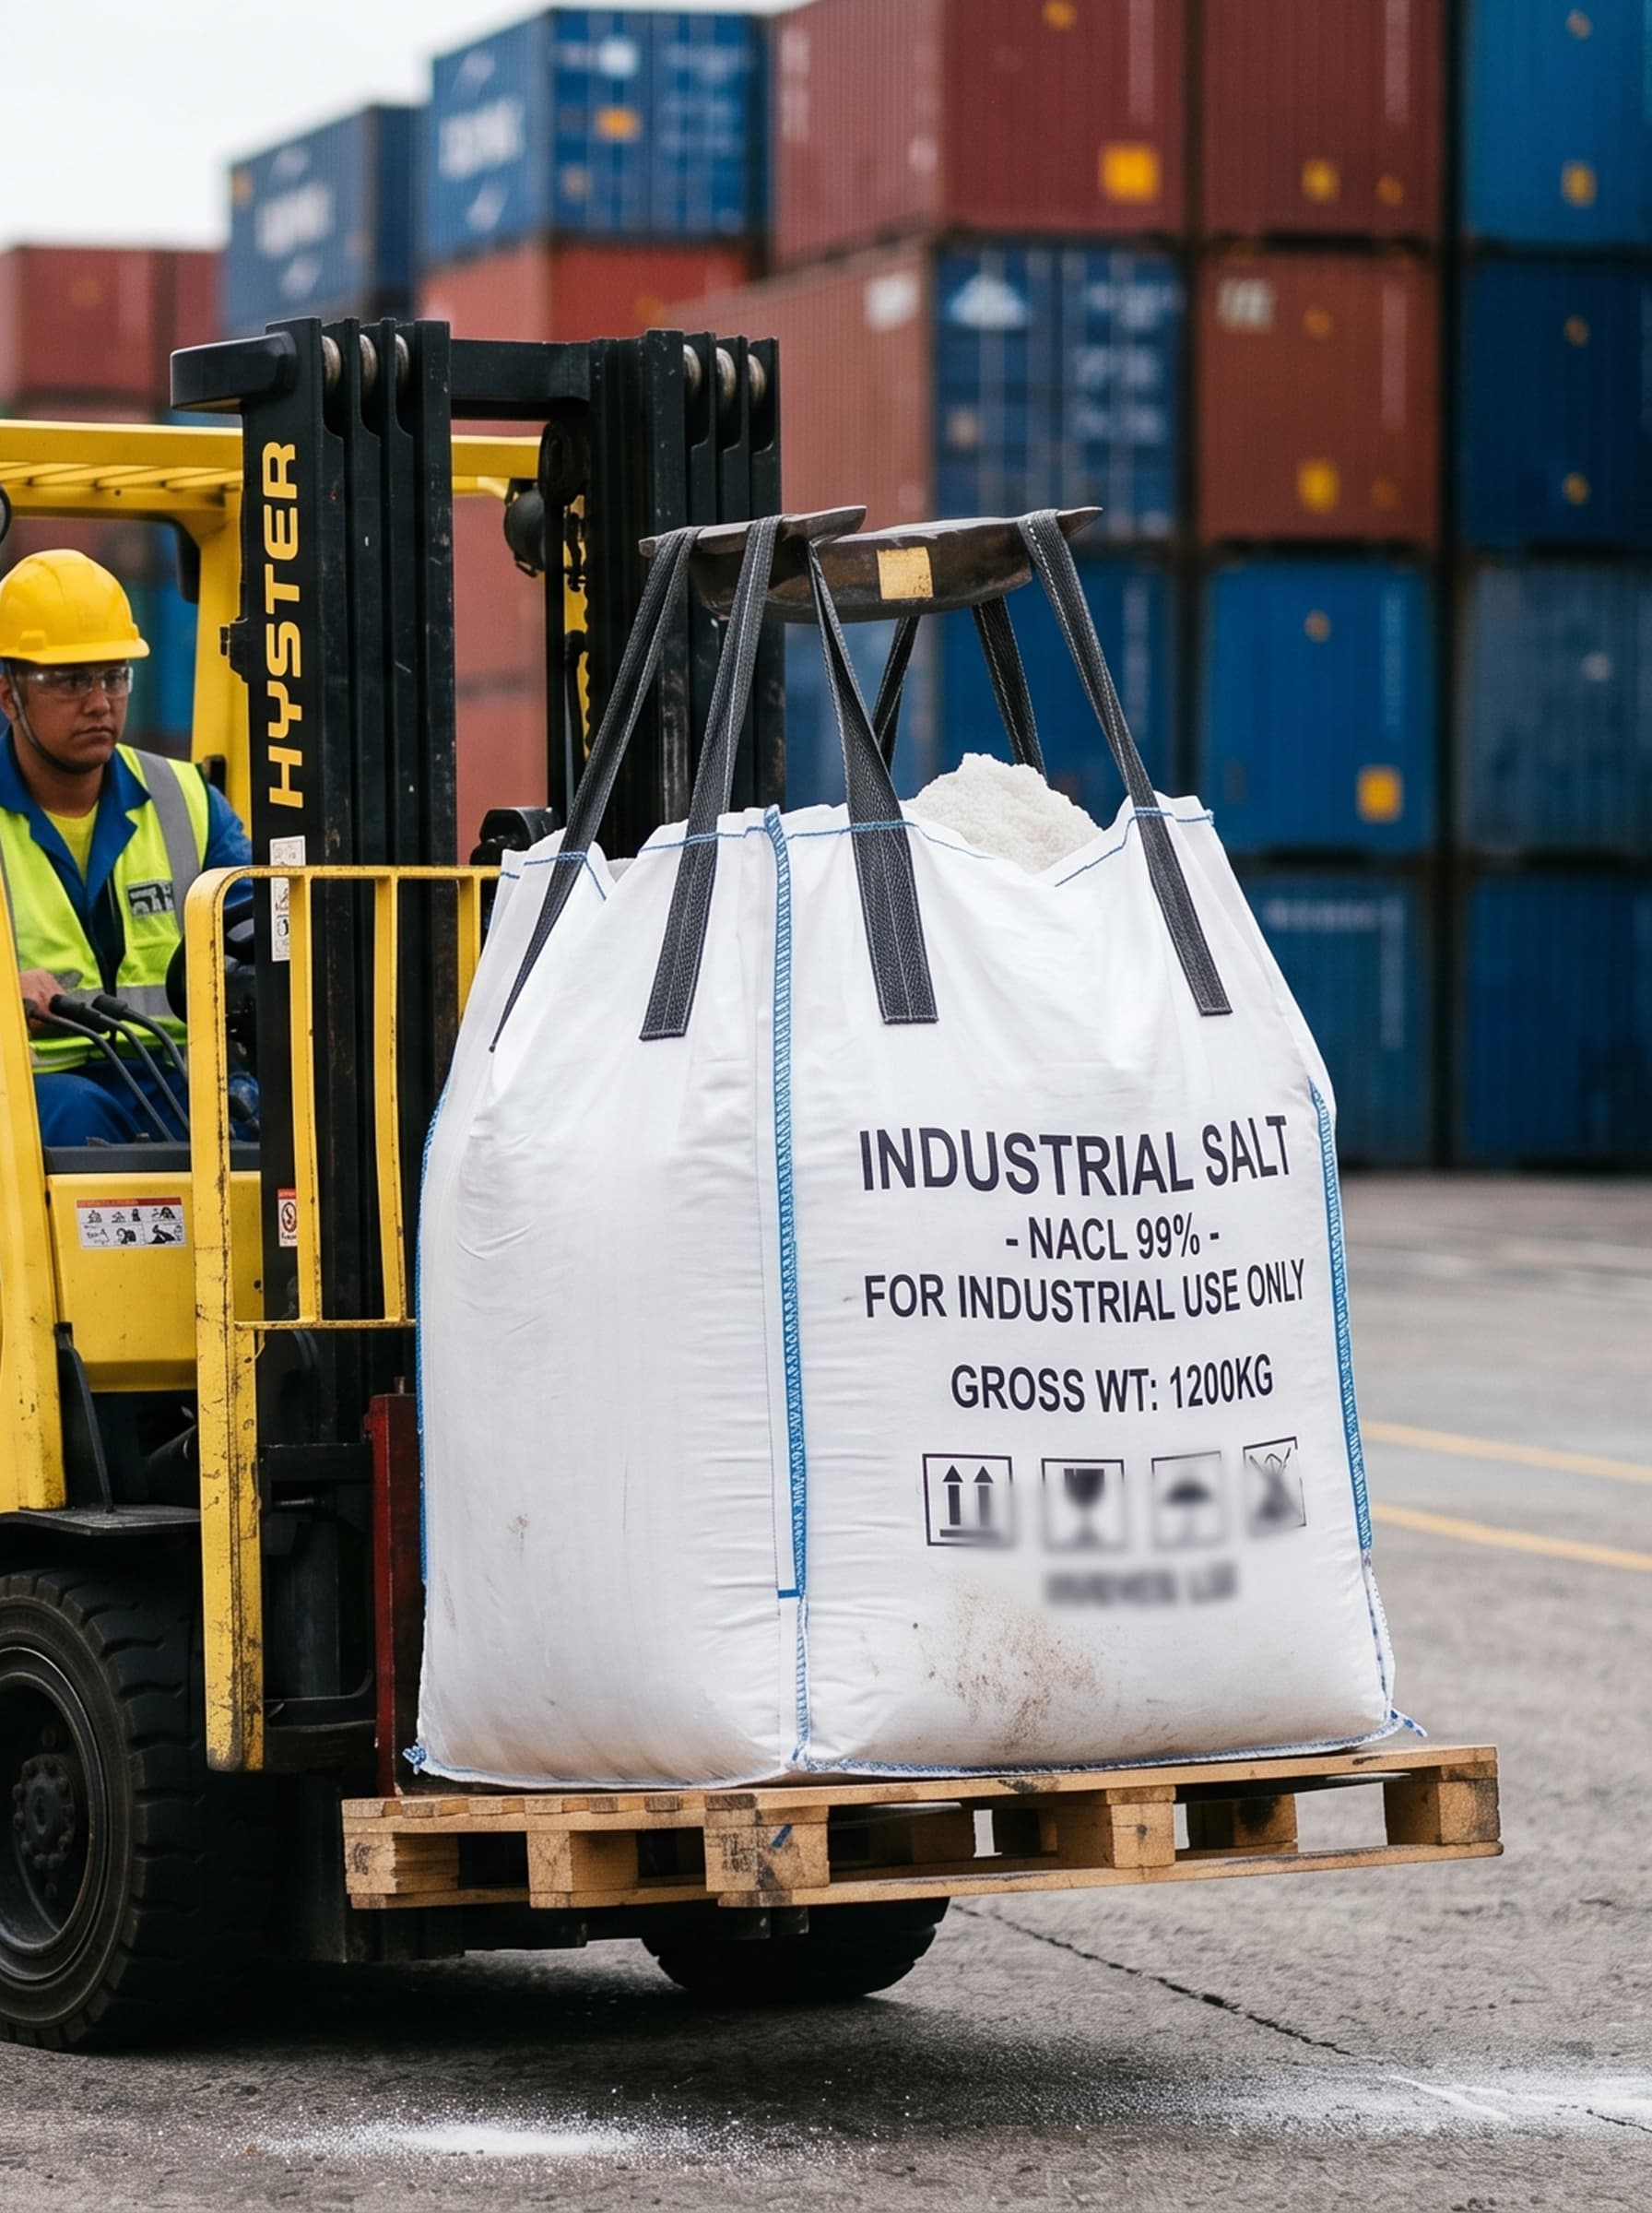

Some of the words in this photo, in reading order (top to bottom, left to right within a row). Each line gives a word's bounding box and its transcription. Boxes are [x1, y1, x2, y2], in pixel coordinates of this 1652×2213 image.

[262, 441, 303, 809] HYSTER
[859, 1127, 1195, 1197] INDUSTRIAL
[1202, 1115, 1290, 1187] SALT
[1028, 1216, 1128, 1261] NACL
[1136, 1212, 1200, 1260] 99%
[864, 1273, 948, 1319] FOR
[958, 1274, 1176, 1323] INDUSTRIAL
[1182, 1268, 1241, 1318] USE
[1246, 1258, 1305, 1308] ONLY
[950, 1364, 1085, 1413] GROSS
[1094, 1367, 1158, 1413] WT:
[1170, 1353, 1273, 1409] 1200KG
